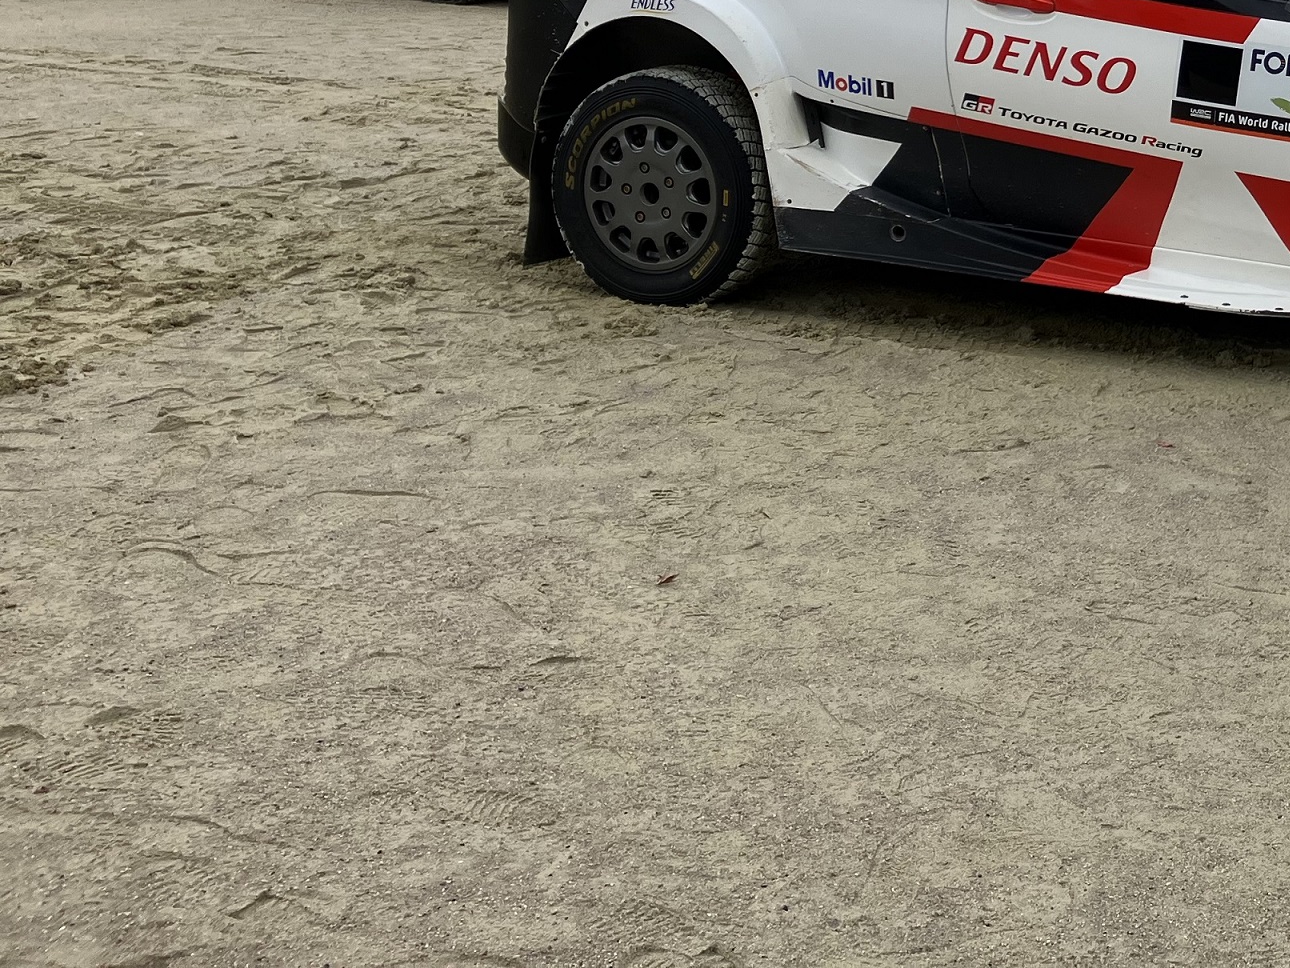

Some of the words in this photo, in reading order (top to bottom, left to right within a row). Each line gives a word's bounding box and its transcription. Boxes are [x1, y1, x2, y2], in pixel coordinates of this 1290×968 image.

[817, 69, 872, 96] Mobil
[954, 28, 1137, 94] DENSO
[565, 98, 638, 191] SCORPION
[962, 98, 994, 115] GR
[998, 106, 1067, 130] TOYOTA
[1072, 122, 1137, 144] GAZOO
[1141, 135, 1203, 158] Racing
[1218, 112, 1235, 125] FIA
[1238, 115, 1269, 129] World
